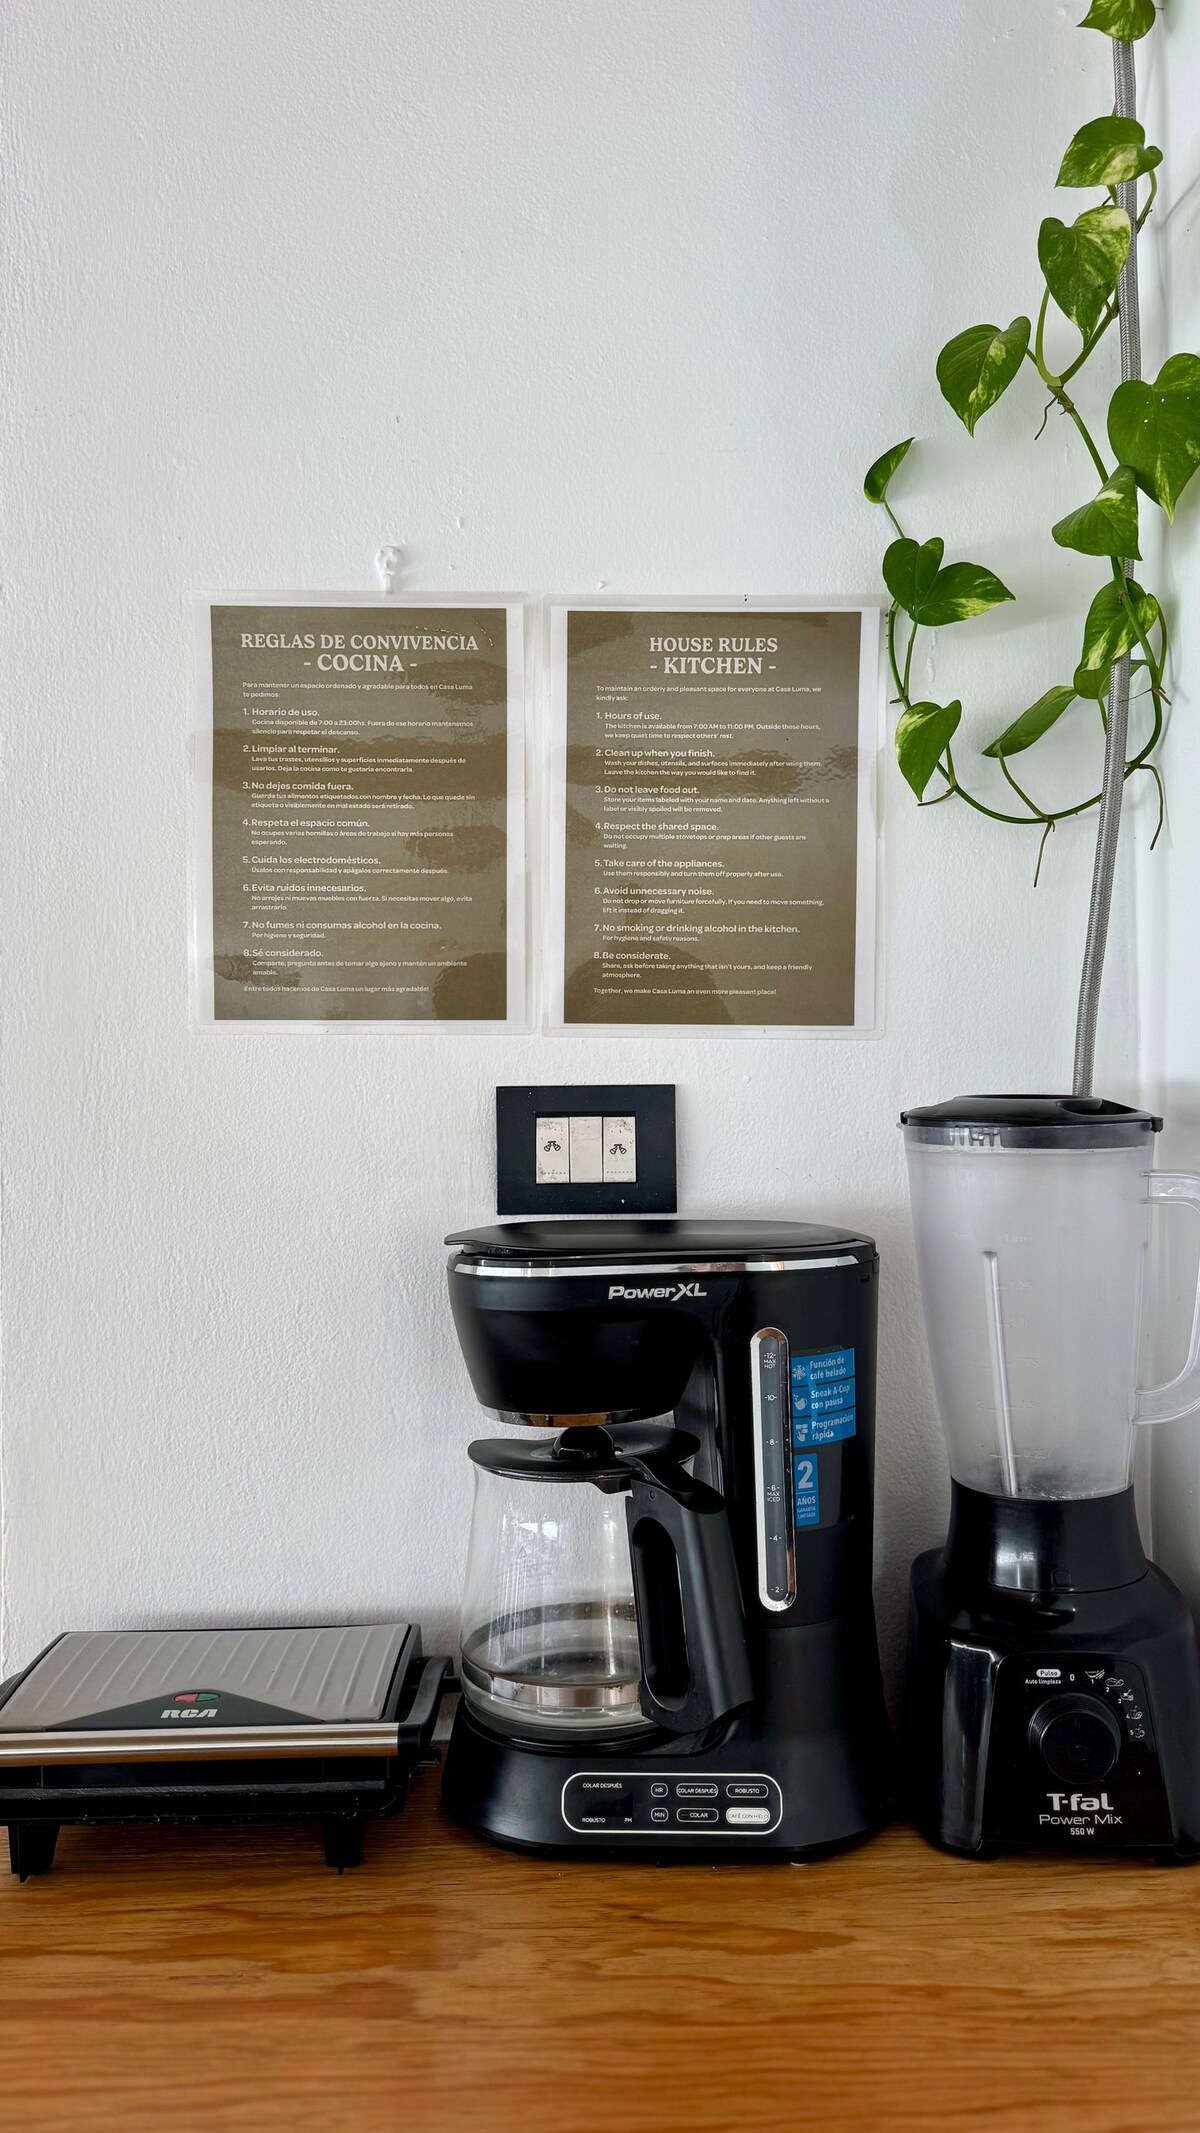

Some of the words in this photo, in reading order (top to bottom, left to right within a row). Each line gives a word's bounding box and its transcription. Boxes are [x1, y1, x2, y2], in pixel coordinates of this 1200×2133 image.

[241, 633, 315, 648] REGLAS
[320, 634, 345, 649] DE
[350, 634, 478, 650] CONVIVENCIA
[649, 637, 713, 652] HOUSE
[718, 637, 778, 652] RULES
[317, 654, 404, 671] COCINA
[664, 657, 762, 674] KITCHEN
[287, 708, 300, 716] de
[633, 712, 643, 720] of
[288, 745, 296, 753] al
[297, 745, 340, 753] terminar.
[631, 750, 643, 758] up
[644, 749, 669, 757] when
[669, 750, 687, 759] you
[688, 749, 715, 757] finish.
[265, 781, 290, 791] dejes
[291, 782, 326, 790] comida
[327, 782, 354, 790] fuera.
[682, 786, 699, 794] out.
[290, 819, 299, 827] el
[299, 818, 335, 828] espacio
[336, 819, 370, 827] común.
[641, 822, 657, 830] the
[658, 822, 689, 830] shared
[690, 824, 719, 832] space.
[279, 855, 293, 864] los
[293, 856, 381, 864] electrodomésticos.
[646, 859, 657, 867] of
[657, 859, 673, 867] the
[673, 859, 724, 869] appliances.
[276, 883, 305, 892] ruidos
[306, 883, 366, 892] innecesarios.
[629, 888, 687, 897] unnecessary
[688, 887, 714, 895] noise.
[265, 920, 294, 929] fumes
[296, 920, 304, 929] ni
[353, 921, 386, 929] alcohol
[400, 921, 408, 929] la
[409, 921, 441, 929] cocina.
[616, 924, 654, 934] smoking
[666, 924, 703, 934] drinking
[704, 924, 737, 933] alcohol
[747, 925, 763, 933] the
[764, 925, 800, 933] kitchen.
[292, 932, 326, 940] seguridad.
[264, 948, 323, 957] considerado.
[615, 951, 671, 960] considerate.
[608, 1282, 707, 1301] PowerXL
[810, 1358, 835, 1370] Función
[835, 1356, 845, 1366] de
[810, 1368, 824, 1380] café
[825, 1366, 846, 1378] helado
[811, 1384, 850, 1399] Sneak-A-Cup
[811, 1400, 823, 1410] con
[824, 1398, 843, 1410] pausa
[811, 1413, 854, 1431] Programación
[812, 1428, 834, 1441] rápida
[797, 1460, 814, 1489] 2
[797, 1496, 816, 1506] AÑOS
[160, 1709, 218, 1718] RCA
[1047, 1793, 1114, 1811] T-fal
[1039, 1814, 1090, 1825] Power
[1095, 1814, 1123, 1825] Mix
